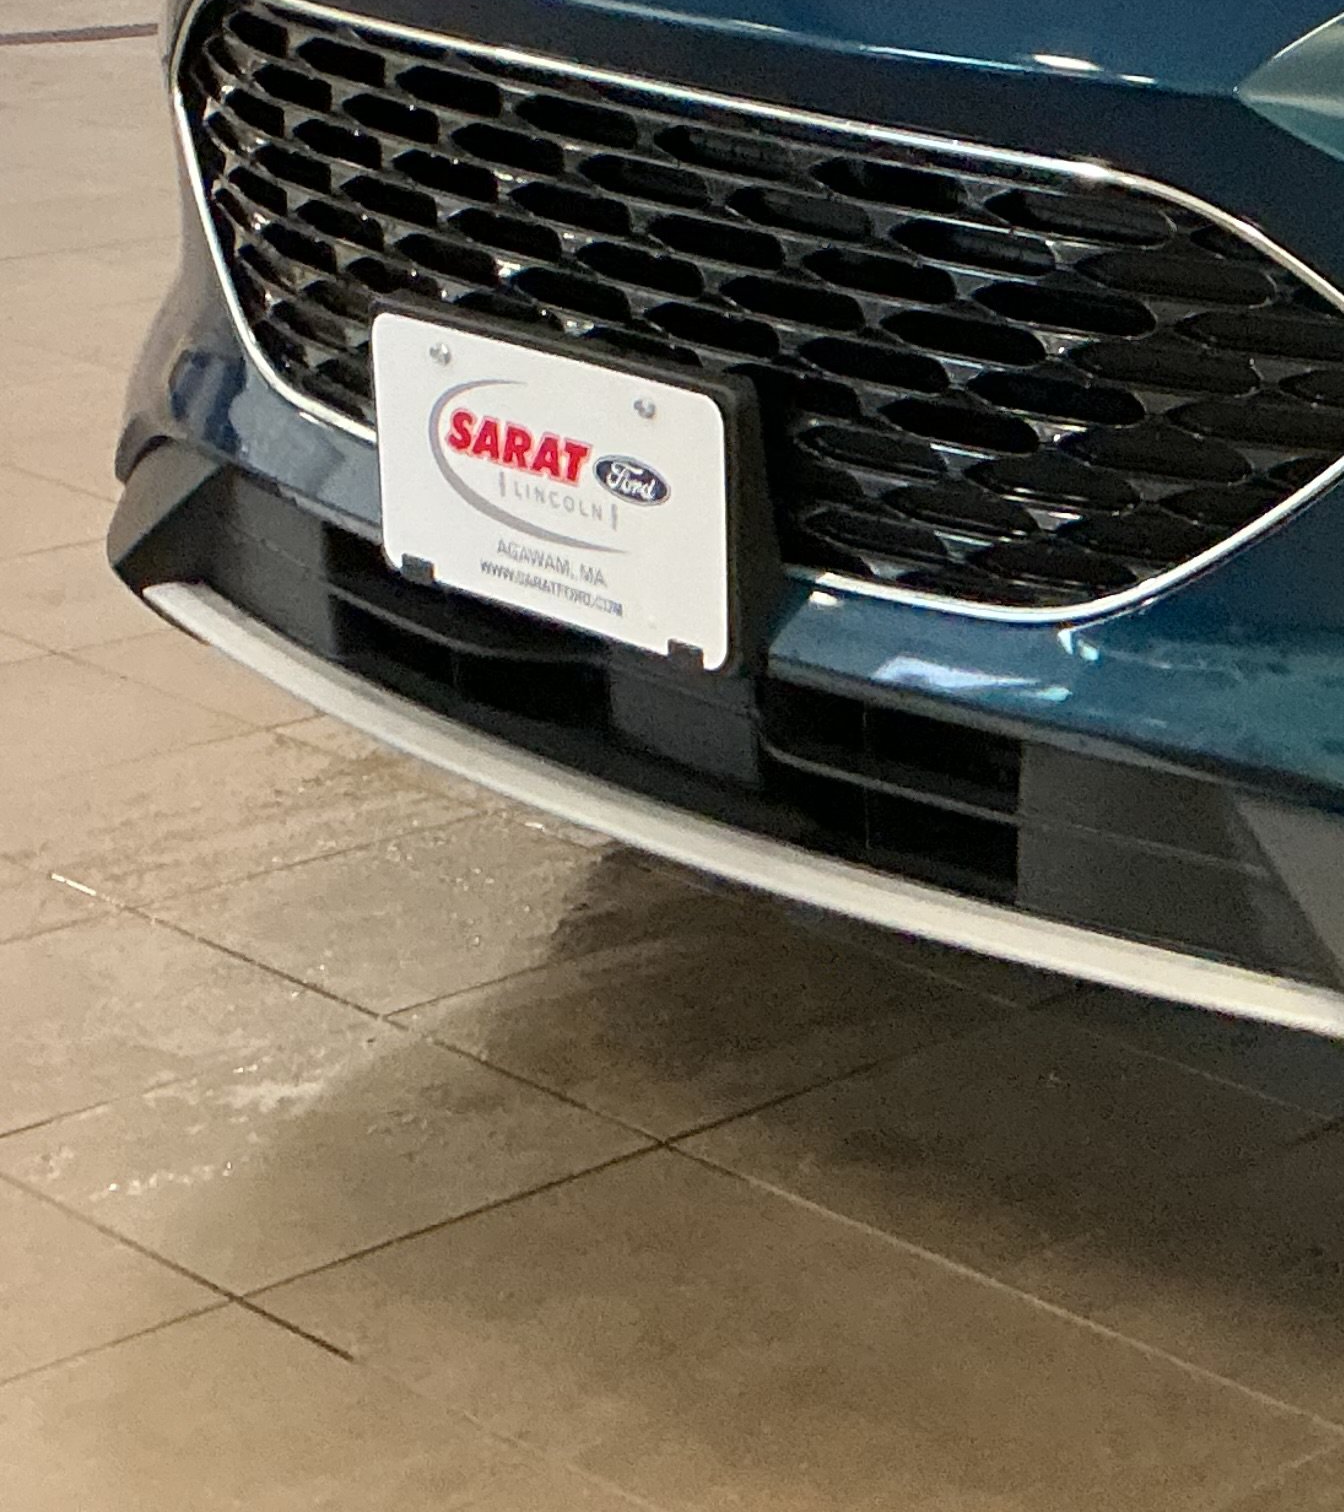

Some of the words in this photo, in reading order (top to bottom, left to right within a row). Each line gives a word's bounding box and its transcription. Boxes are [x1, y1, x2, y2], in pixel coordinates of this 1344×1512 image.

[447, 408, 593, 486] SARAT
[606, 460, 657, 500] Ford
[513, 481, 603, 521] LINCOLN
